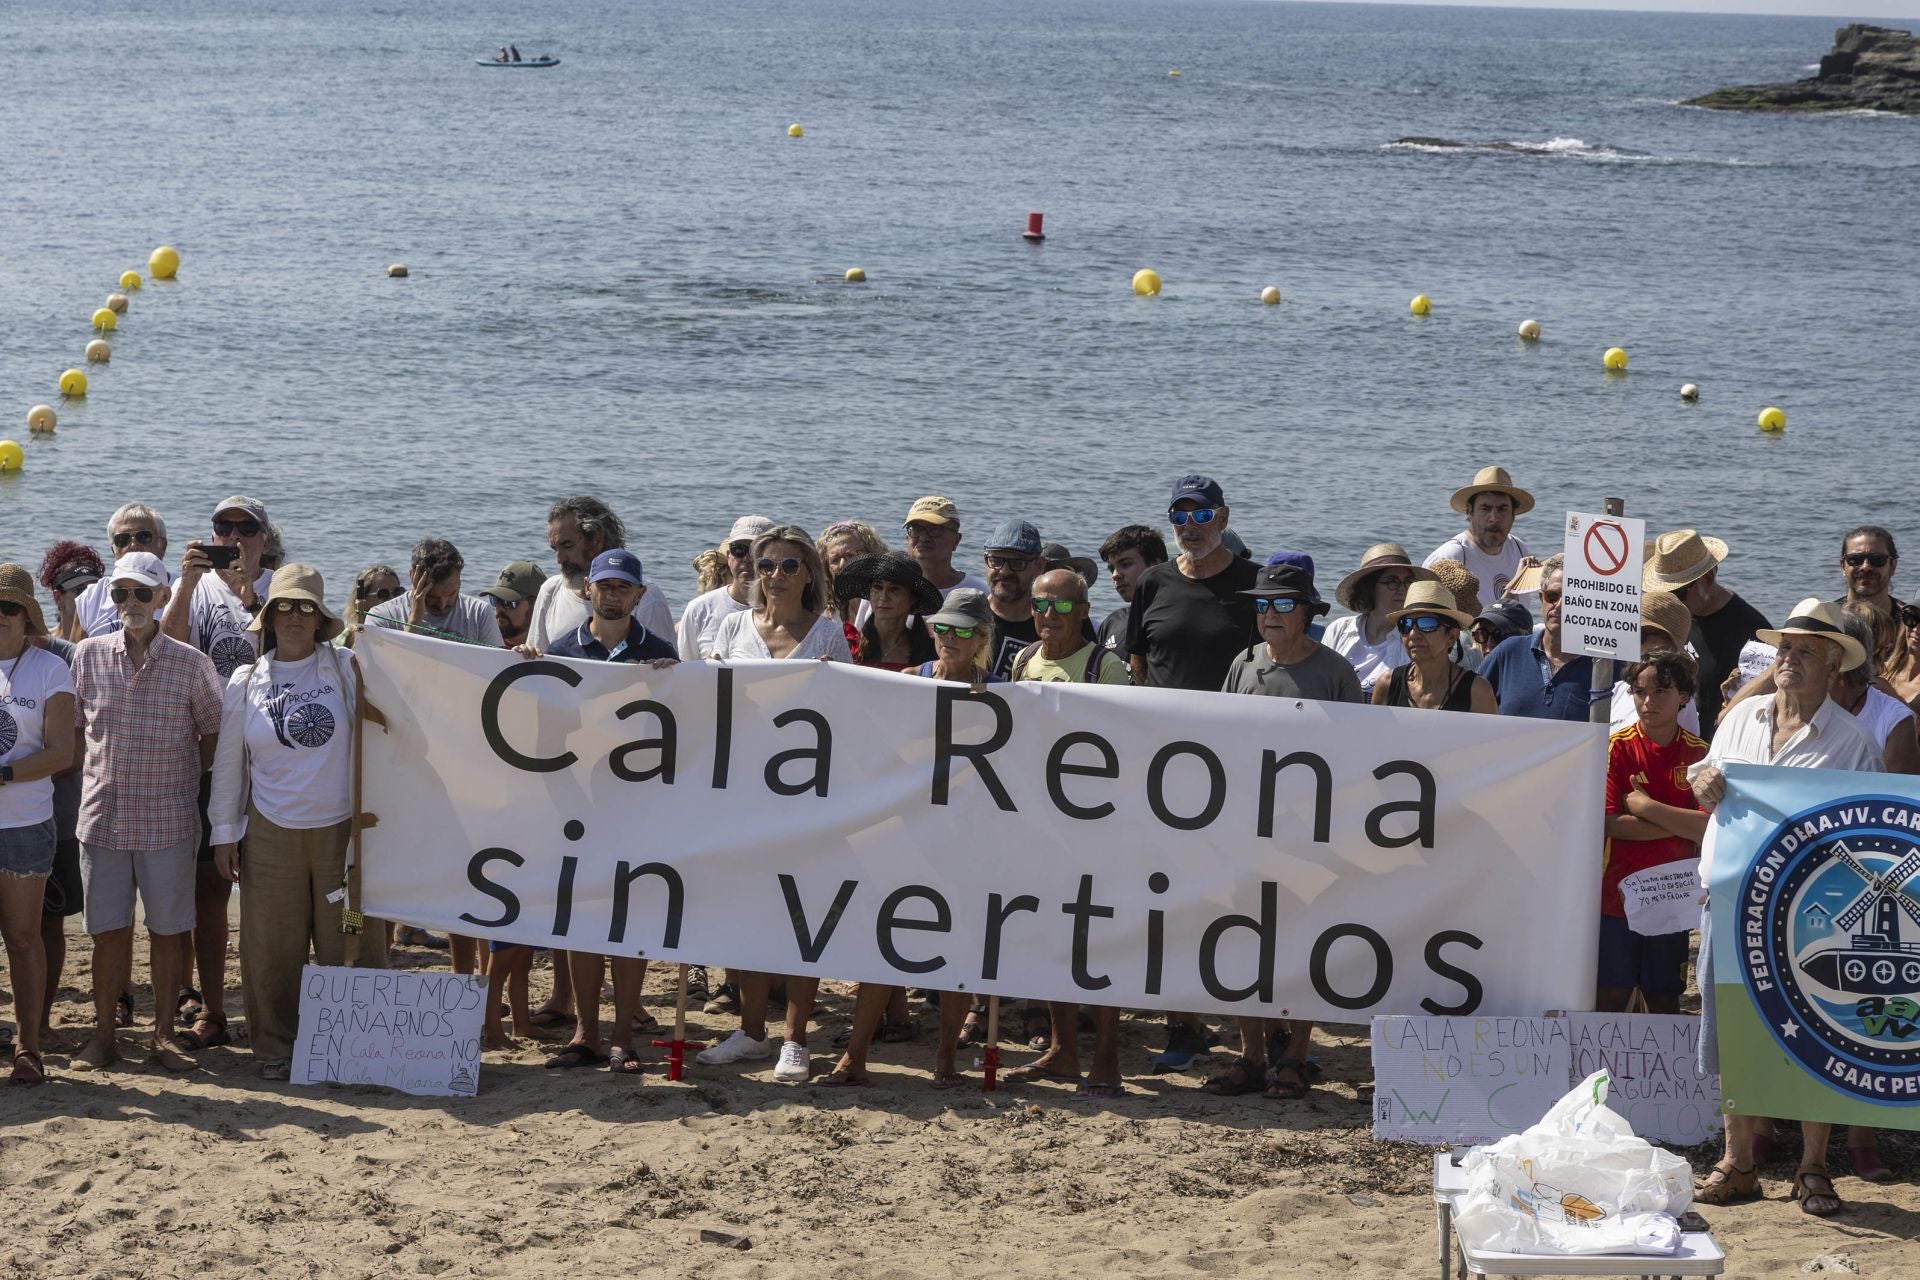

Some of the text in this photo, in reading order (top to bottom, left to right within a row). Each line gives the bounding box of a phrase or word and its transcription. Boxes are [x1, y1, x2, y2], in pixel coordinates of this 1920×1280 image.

[1567, 578, 1638, 596] PROHIBIDO EL
[1564, 595, 1639, 614] BAÑO EN ZONA
[1564, 614, 1638, 632] ACOTADA CON
[1584, 635, 1618, 648] BOYAS
[0, 695, 36, 710] CABO
[481, 661, 1437, 849] Cala Reona
[459, 820, 1484, 1017] sin vertidos
[1746, 850, 1786, 992] FEDERACIÓN
[307, 973, 481, 1011] QUEREMOS
[317, 1003, 454, 1037] BAÑARNOS
[1382, 1016, 1567, 1052] CALA REONA
[309, 1033, 344, 1056] EN
[350, 1037, 385, 1060] Cala
[451, 1039, 480, 1062] NO
[1598, 1021, 1660, 1050] CALA
[307, 1058, 341, 1082] EN
[1422, 1051, 1551, 1082] NO ES UN
[1824, 1056, 1886, 1093] ISAAC
